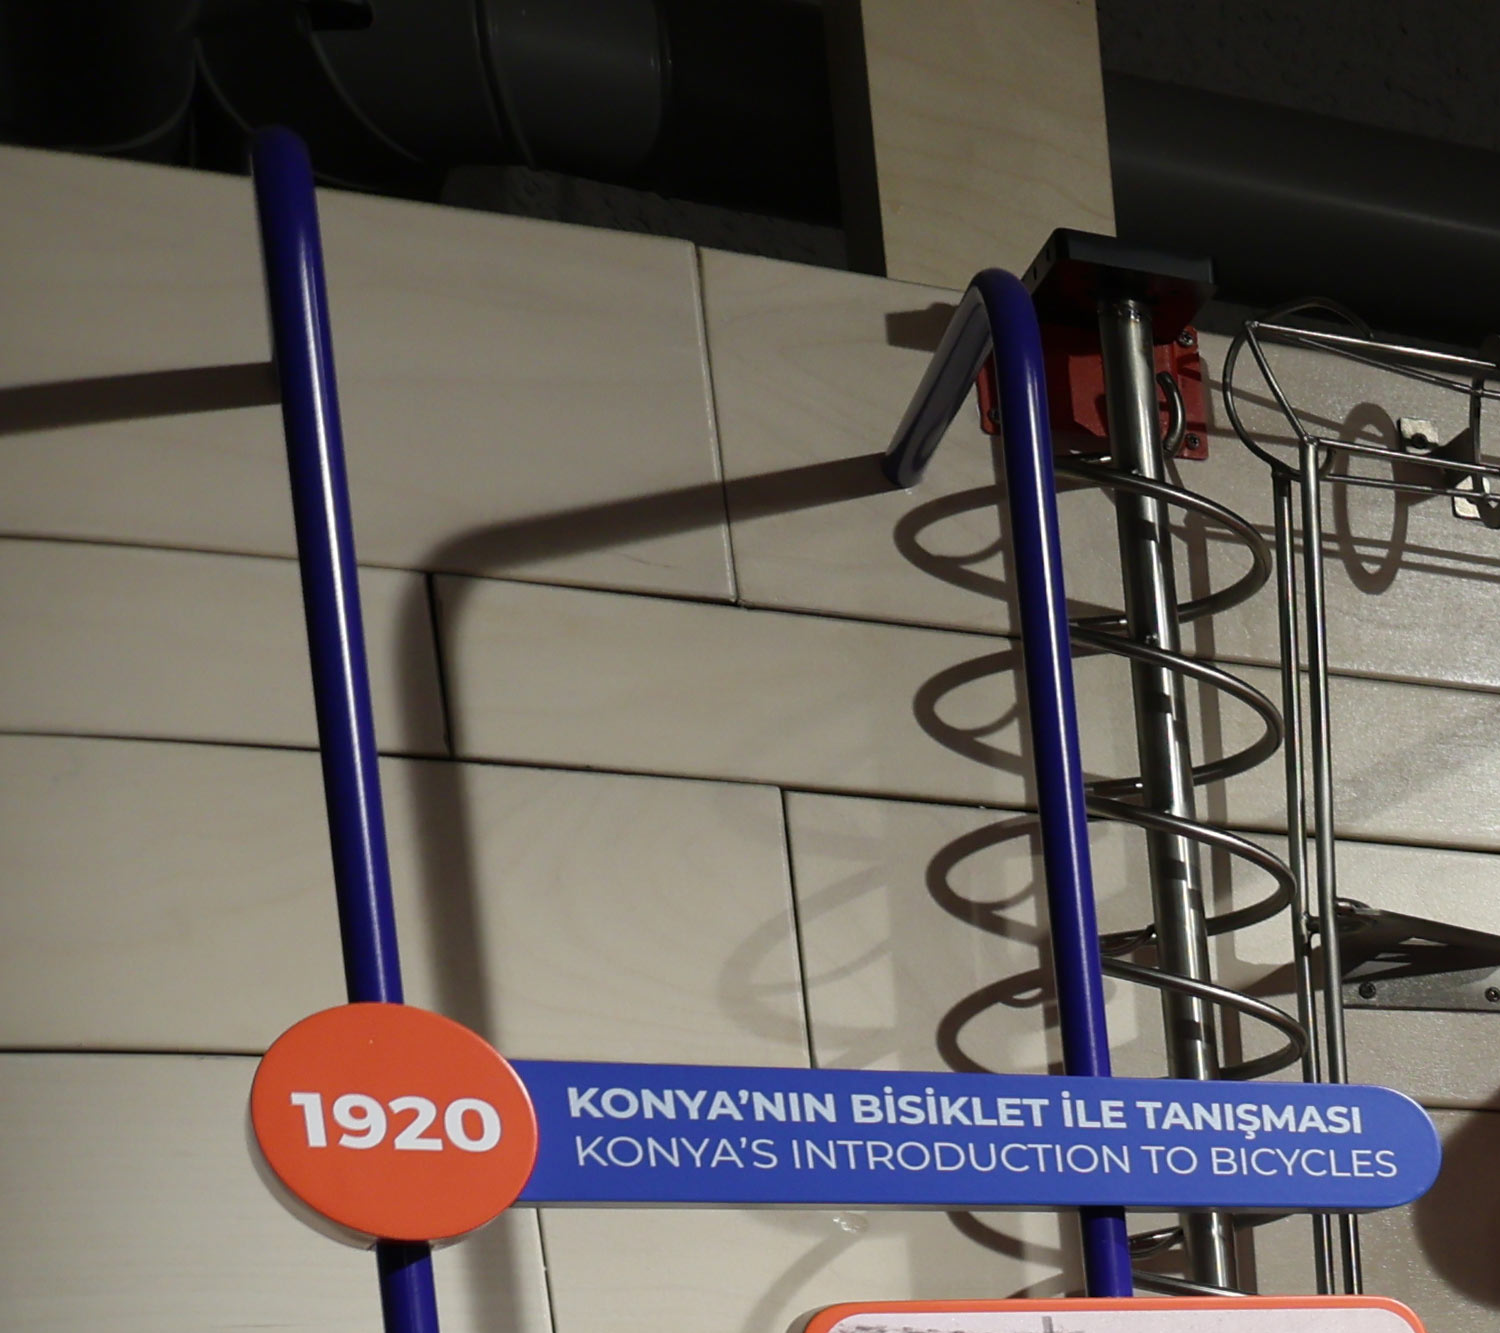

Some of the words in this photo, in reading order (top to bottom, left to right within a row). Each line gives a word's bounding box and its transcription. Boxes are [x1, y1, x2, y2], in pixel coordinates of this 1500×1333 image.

[290, 1091, 501, 1152] 1920
[567, 1087, 836, 1122] KONYA'NIN
[850, 1086, 1049, 1128] BİSİKLET
[1062, 1090, 1127, 1129] İLE
[1137, 1100, 1362, 1139] TANIŞMASI
[576, 1136, 778, 1169] KONYA'S
[794, 1139, 1129, 1174] INTRODUCTION
[1141, 1145, 1198, 1175] TO
[1212, 1146, 1398, 1178] BICYCLES
